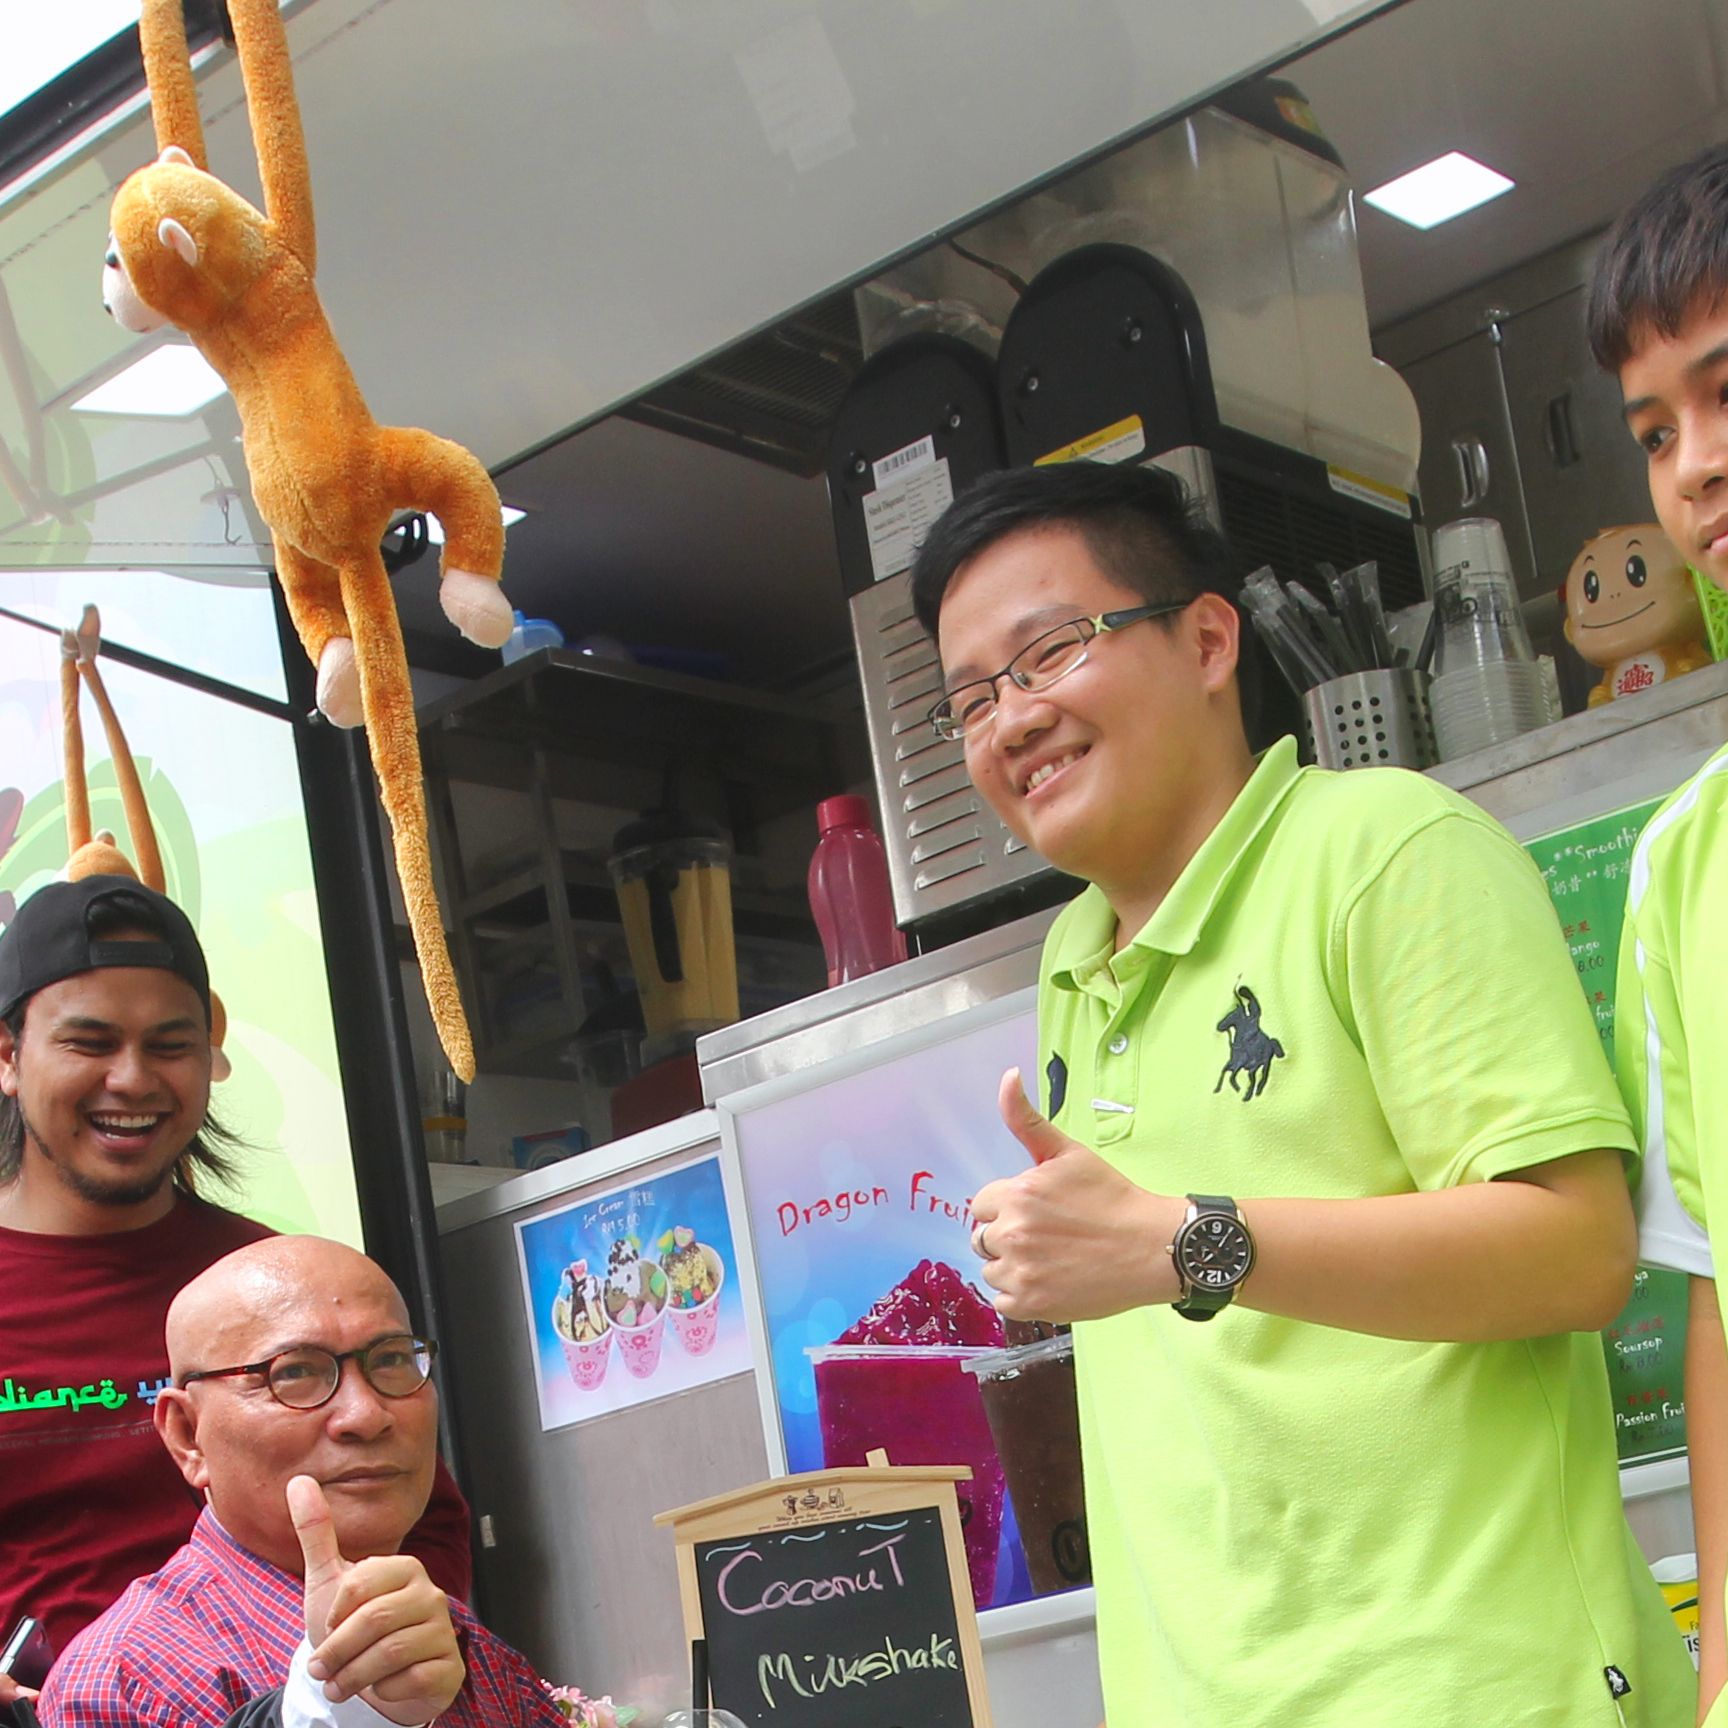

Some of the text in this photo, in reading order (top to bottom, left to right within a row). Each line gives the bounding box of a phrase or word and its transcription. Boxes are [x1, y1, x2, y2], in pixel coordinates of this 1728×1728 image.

[1568, 940, 1600, 957] ango
[776, 1187, 889, 1237] Dragon
[1614, 1337, 1664, 1356] Soursop
[1616, 1411, 1658, 1429] Passion
[758, 1633, 959, 1709] Milkshake
